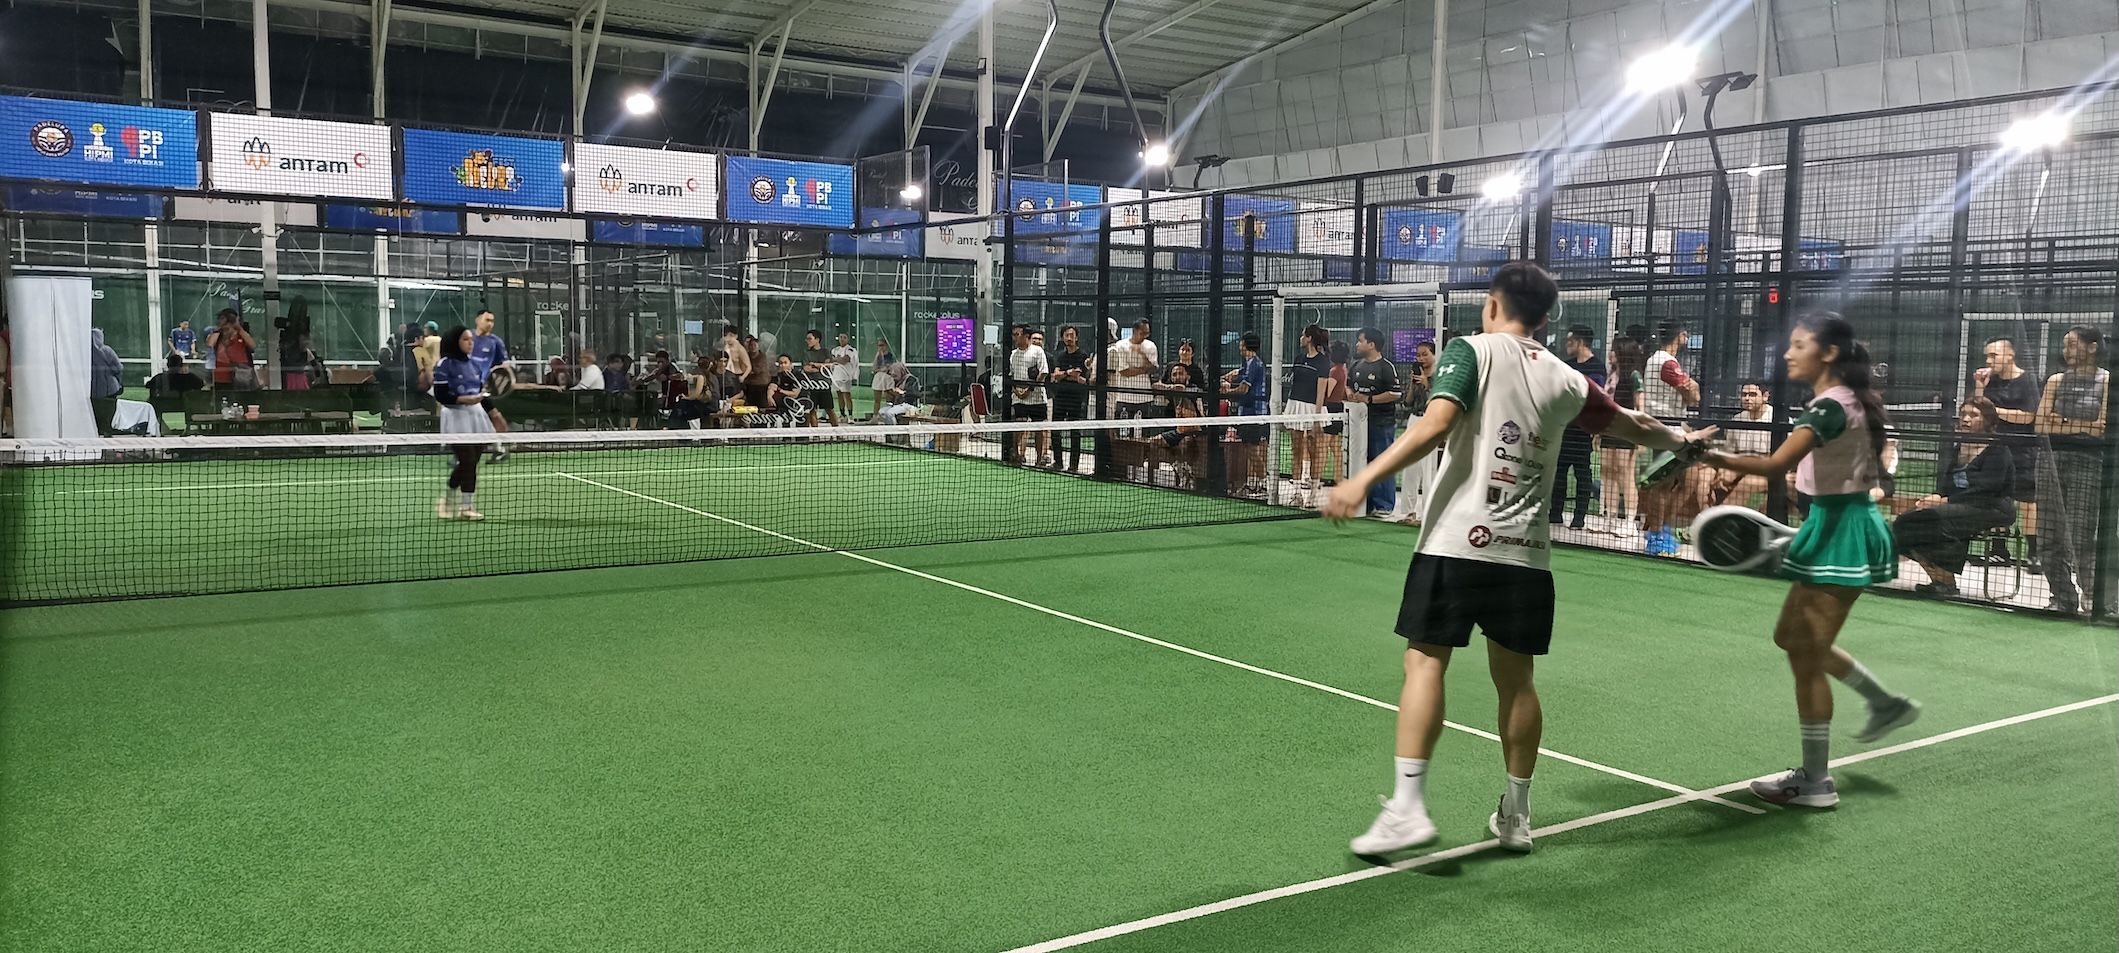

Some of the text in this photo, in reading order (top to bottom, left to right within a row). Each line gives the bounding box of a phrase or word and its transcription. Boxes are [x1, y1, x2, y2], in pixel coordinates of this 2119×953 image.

[138, 129, 164, 145] PB
[84, 149, 114, 160] HIPMI
[139, 144, 158, 159] PI
[933, 159, 978, 188] Pade
